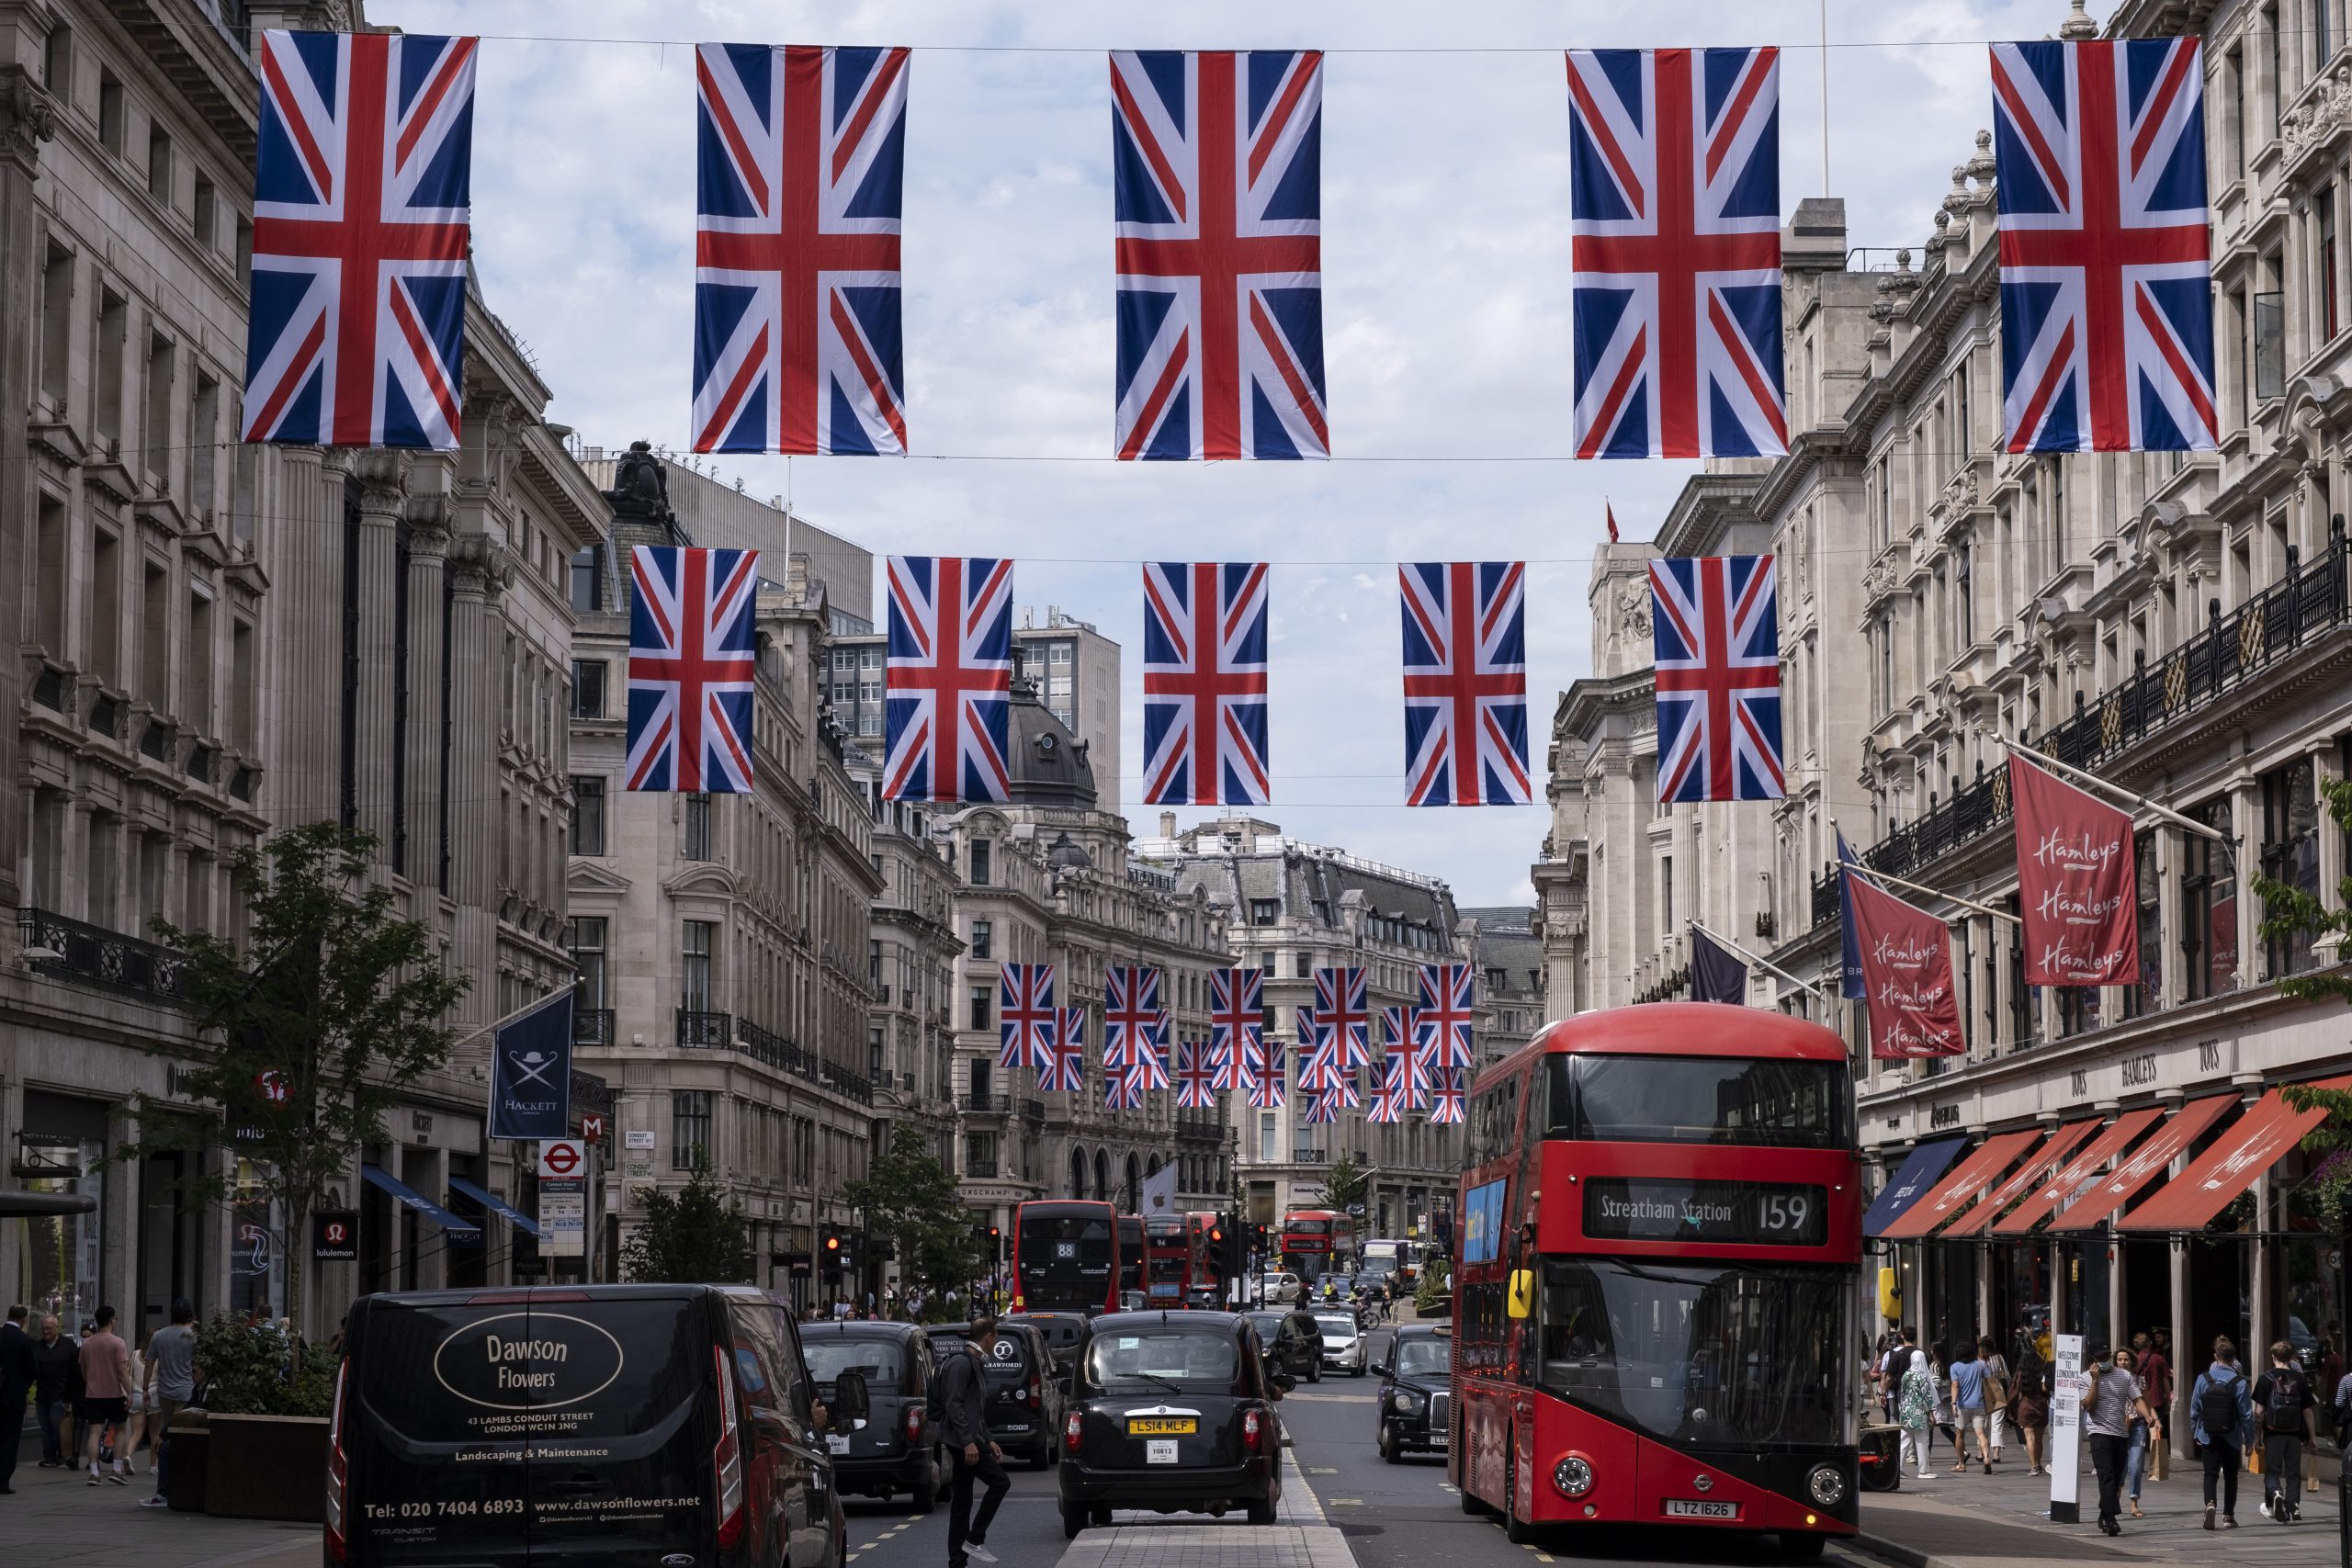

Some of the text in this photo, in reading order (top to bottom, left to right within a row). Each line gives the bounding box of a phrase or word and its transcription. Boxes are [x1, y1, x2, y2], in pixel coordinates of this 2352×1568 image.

[2033, 827, 2120, 872] Hamleys
[2036, 880, 2121, 926] Hamleys
[1872, 933, 1939, 969] Hamleys
[2038, 934, 2123, 980] Hamleys
[1878, 976, 1943, 1011] Hamleys
[1882, 1018, 1950, 1052] Hamleys
[2121, 1053, 2157, 1088] HAMLEYS
[2198, 1038, 2220, 1072] TOYS
[505, 1100, 558, 1111] HACKETT
[583, 1119, 602, 1136] M
[1601, 1195, 1807, 1229] Streatham Station 159
[316, 1248, 354, 1258] lululemon
[1058, 1245, 1073, 1257] 88
[487, 1335, 568, 1363] Dawson
[2058, 1351, 2079, 1360] WELCOME
[498, 1367, 555, 1388] Flowers
[2057, 1370, 2079, 1379] LONDON'S
[2057, 1379, 2079, 1388] WEST END
[481, 1416, 512, 1425] LAMBS
[514, 1414, 557, 1423] CONDUIT
[560, 1412, 594, 1421] STREET
[1137, 1420, 1188, 1432] LS14 MLF
[484, 1424, 526, 1433] LONDON
[558, 1422, 578, 1431] 3NG
[455, 1448, 609, 1461] Landscaping & Maintenance
[364, 1499, 524, 1518] Tel: 020 7404 6893
[534, 1495, 701, 1512] www.dawsonflowers.net
[1674, 1503, 1729, 1516] LTZ 1626
[371, 1527, 436, 1536] TRANSIT
[667, 1557, 689, 1565] Ford
